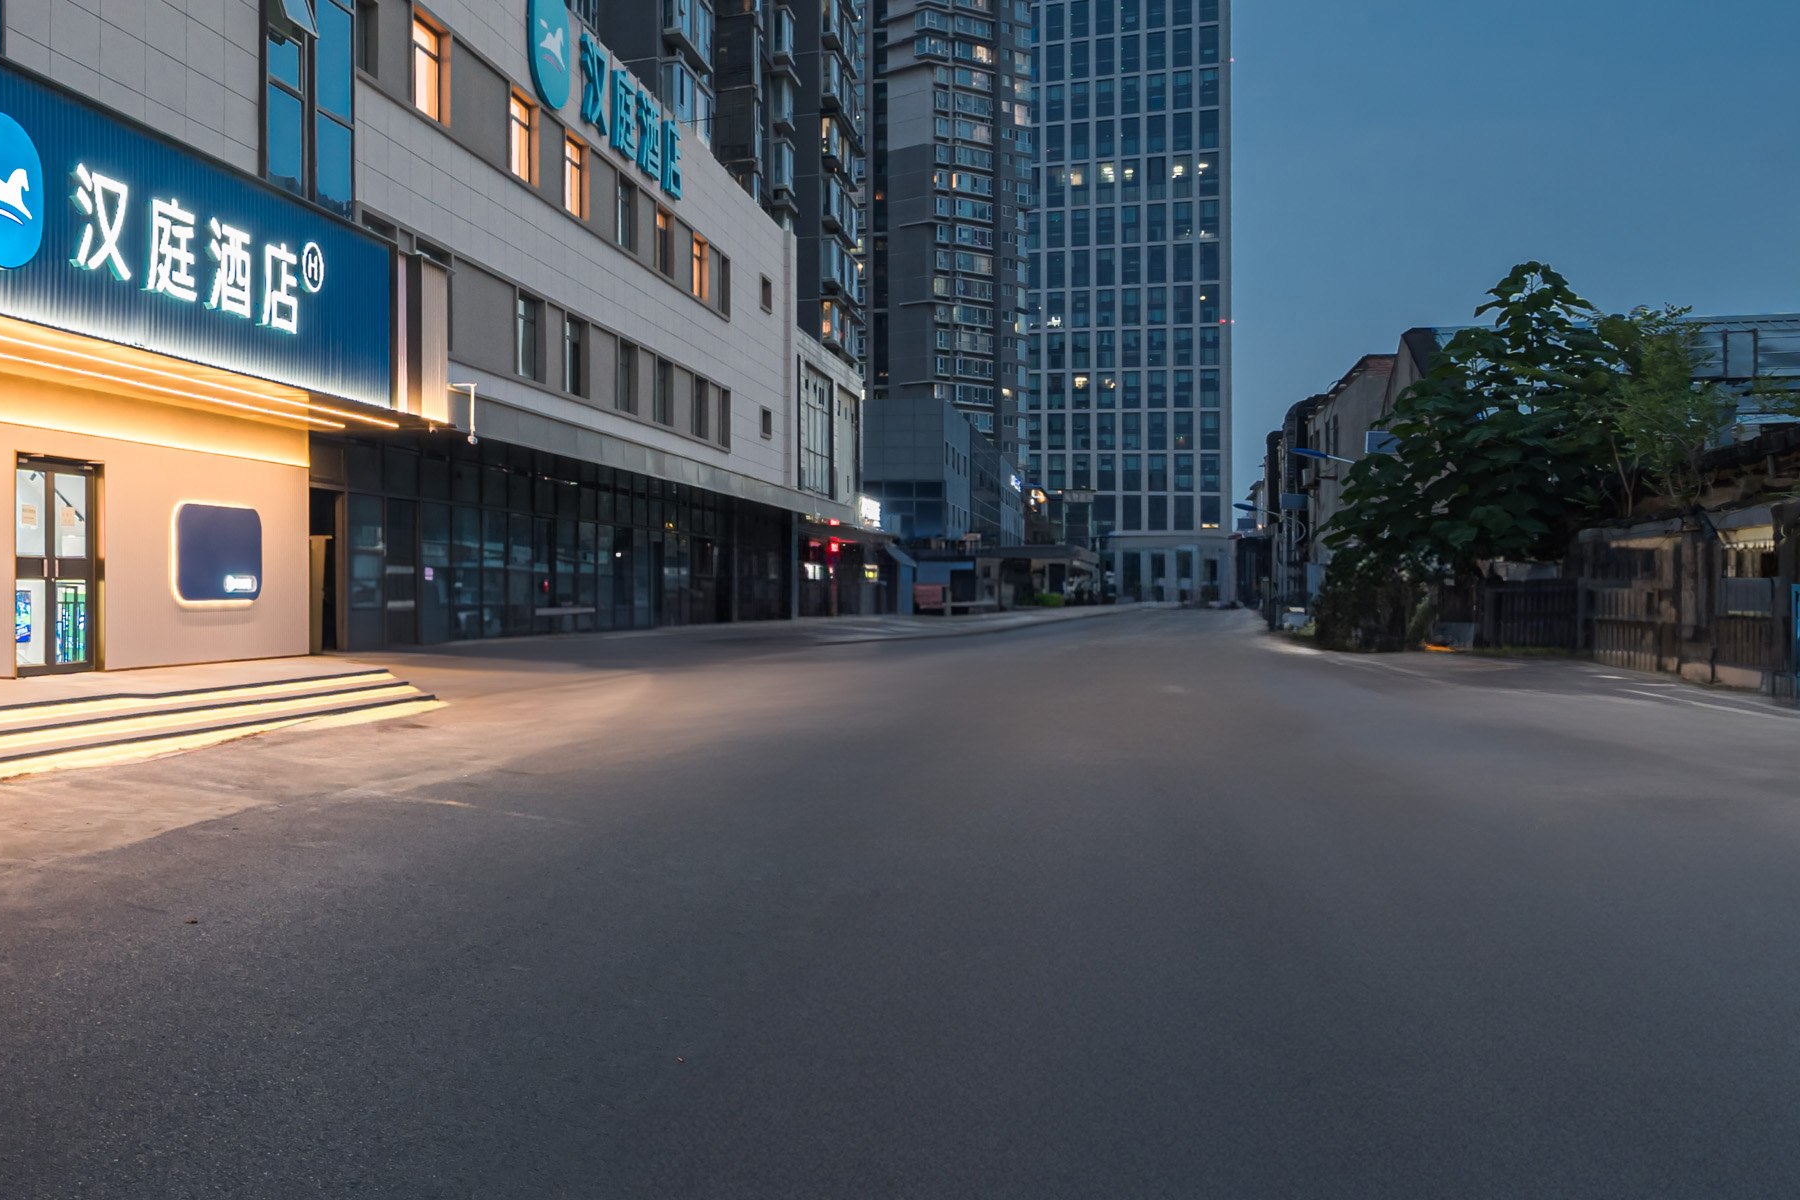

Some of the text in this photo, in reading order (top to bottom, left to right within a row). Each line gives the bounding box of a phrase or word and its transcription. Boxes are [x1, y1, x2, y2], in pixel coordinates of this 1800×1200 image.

[581, 33, 682, 201] 汉庭酒店
[70, 161, 299, 335] 汉庭酒店
